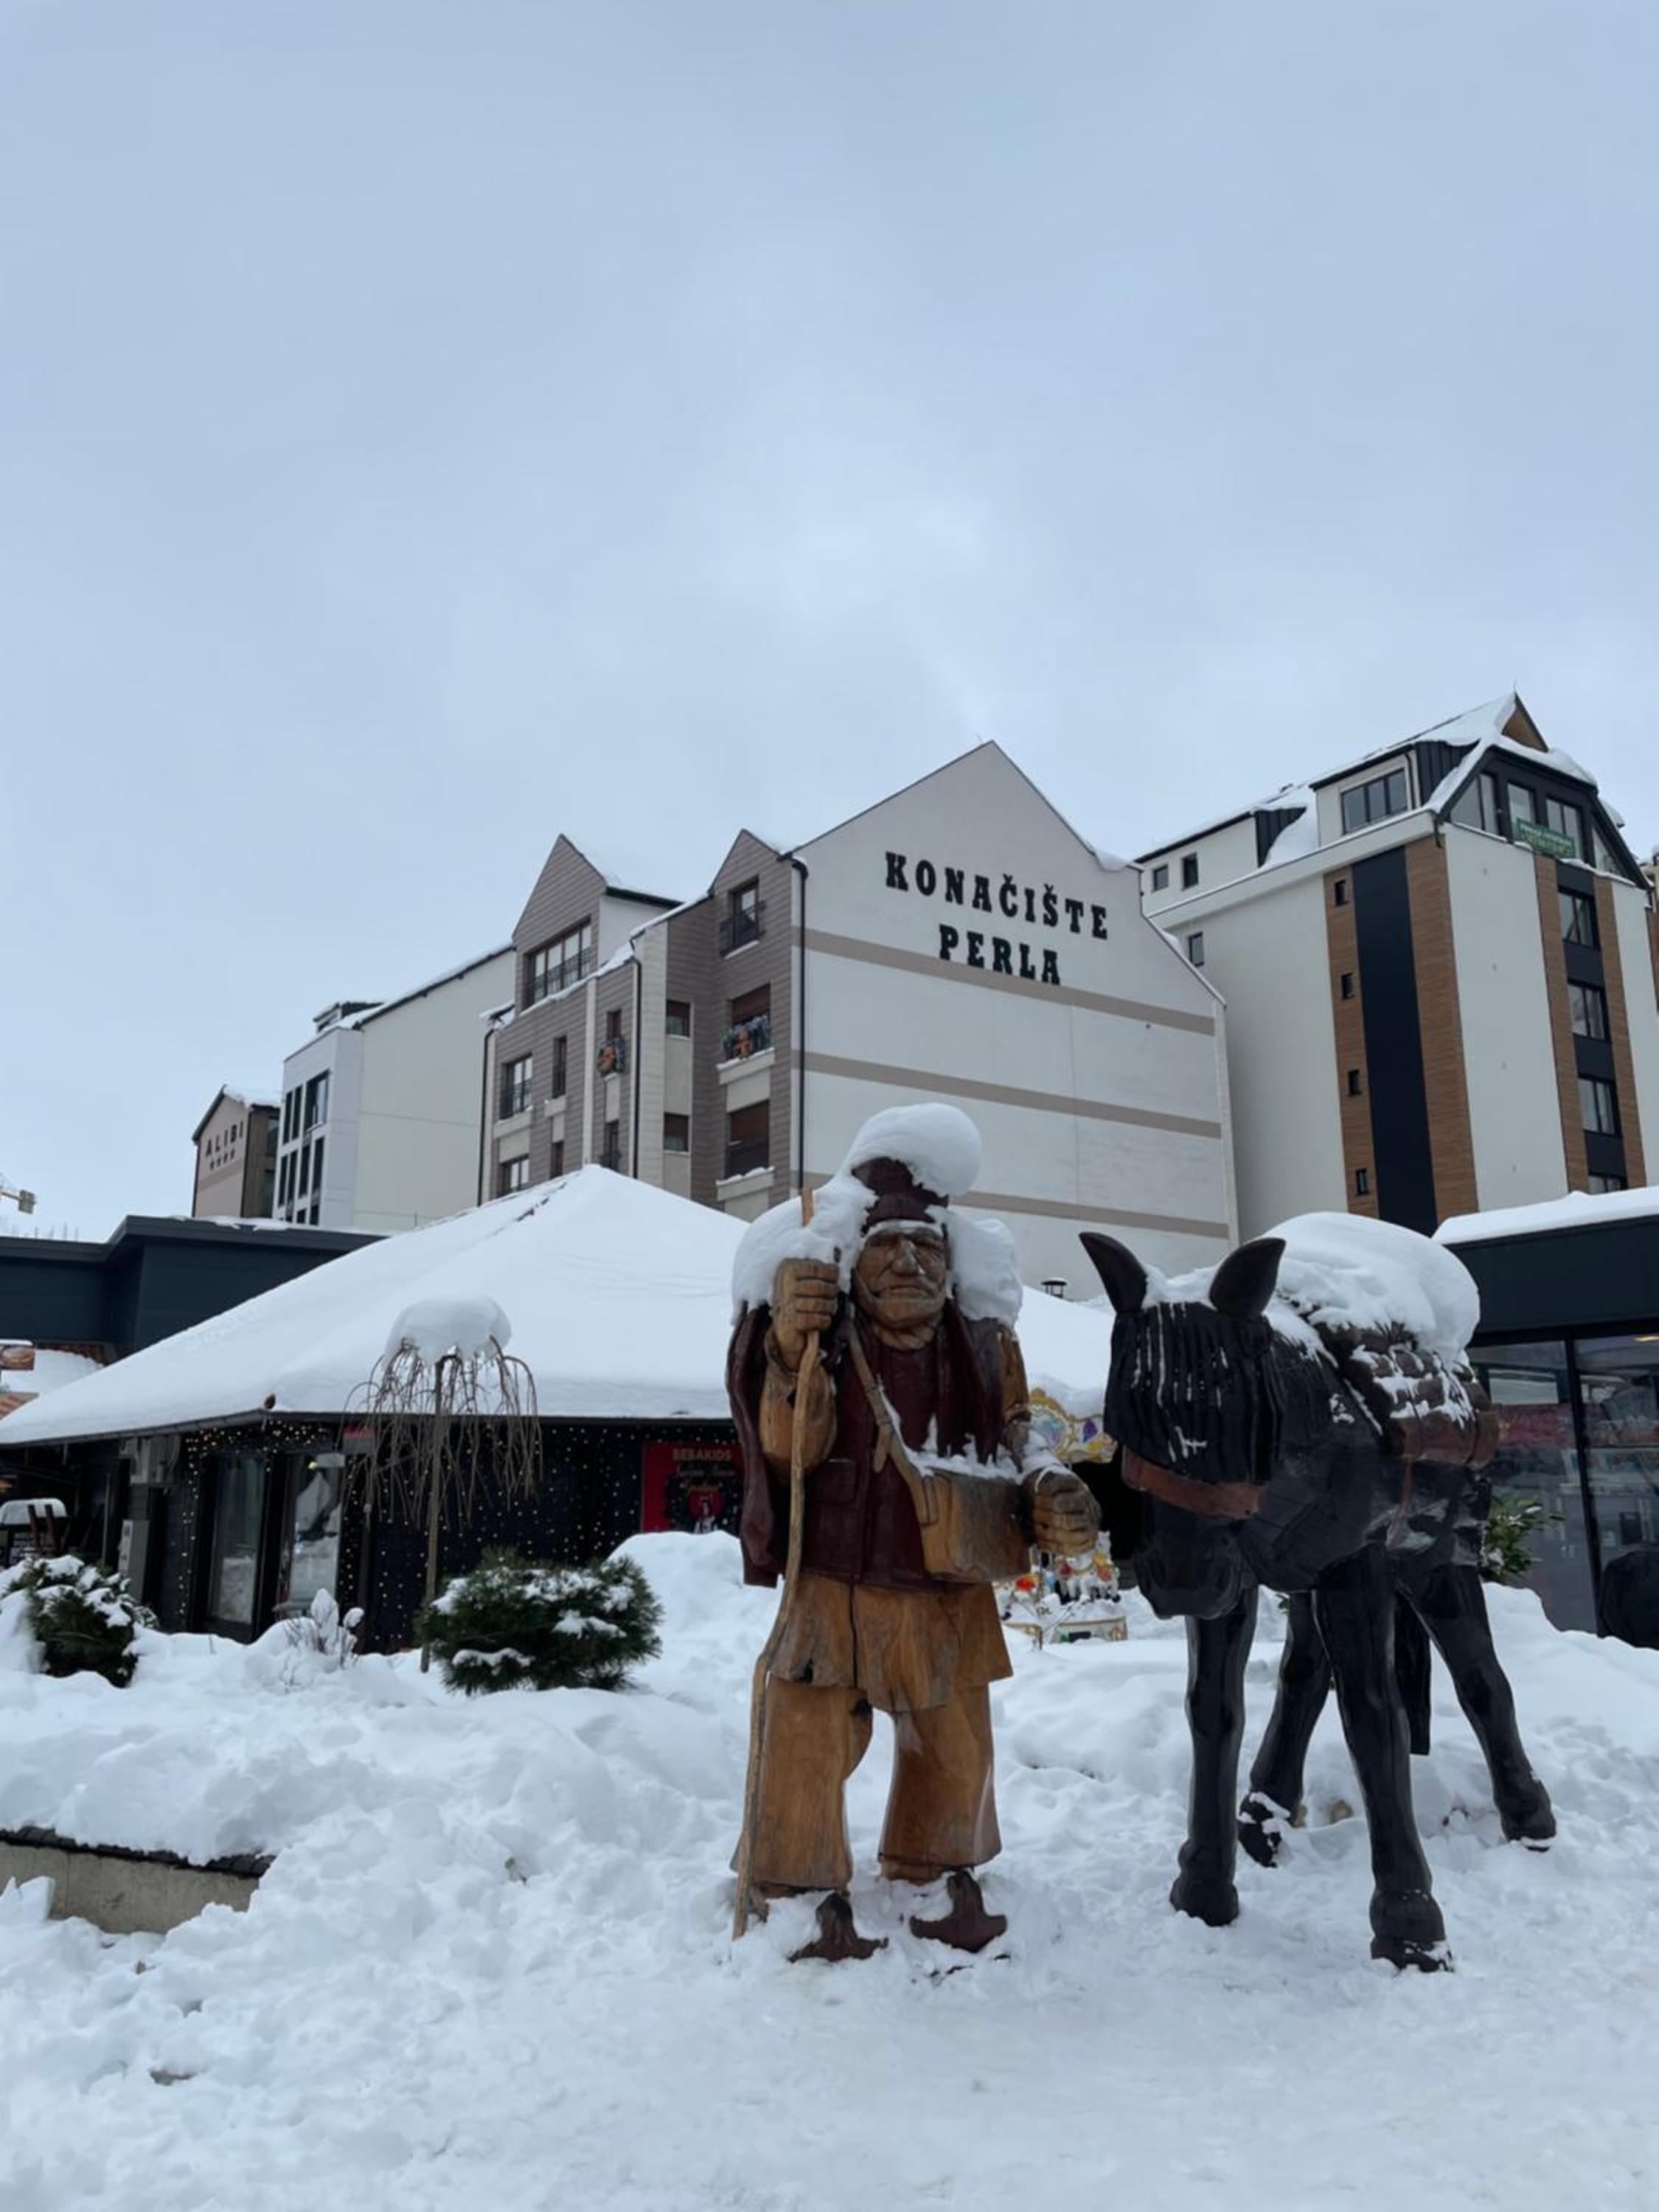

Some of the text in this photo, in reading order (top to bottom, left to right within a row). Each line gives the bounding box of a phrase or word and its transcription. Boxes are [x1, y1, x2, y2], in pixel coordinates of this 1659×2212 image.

[886, 851, 1108, 940] KONAČIŠTE
[939, 923, 1060, 986] PERLA
[206, 1120, 244, 1157] ALIBI
